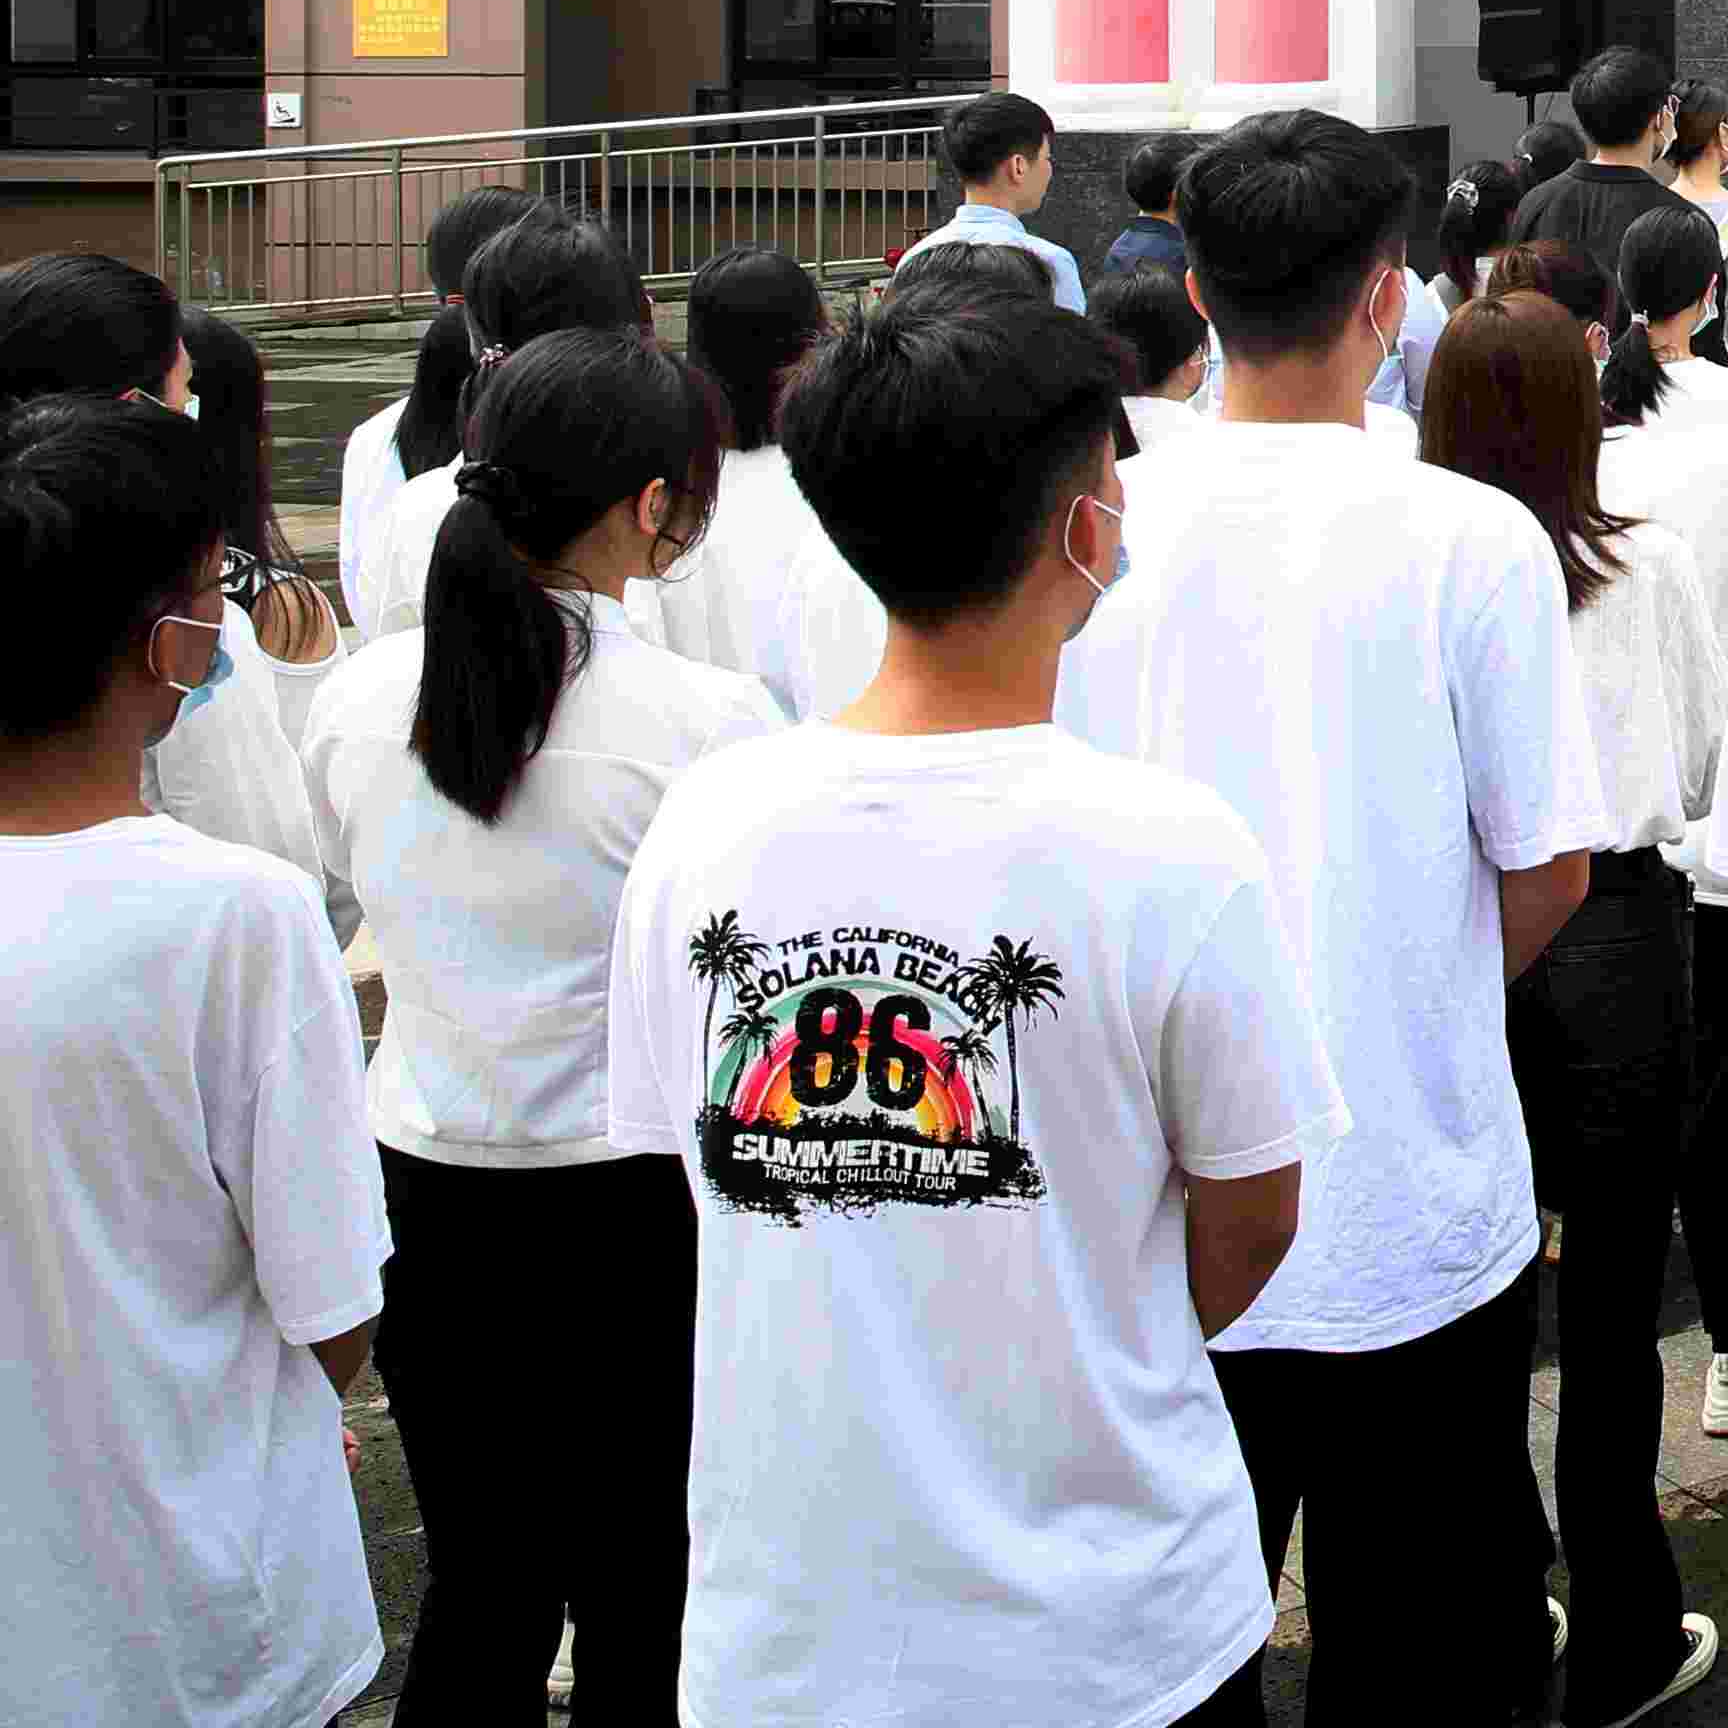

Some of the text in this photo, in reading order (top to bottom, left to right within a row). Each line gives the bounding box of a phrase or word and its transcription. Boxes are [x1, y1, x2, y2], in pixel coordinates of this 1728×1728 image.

[777, 926, 960, 968] THE CALIFORNIA
[737, 947, 881, 1012] SOLANA
[789, 988, 932, 1111] 86
[732, 1133, 990, 1177] SUMMERTIME
[763, 1163, 957, 1191] TROPICAL CHILLOUT TOUR
